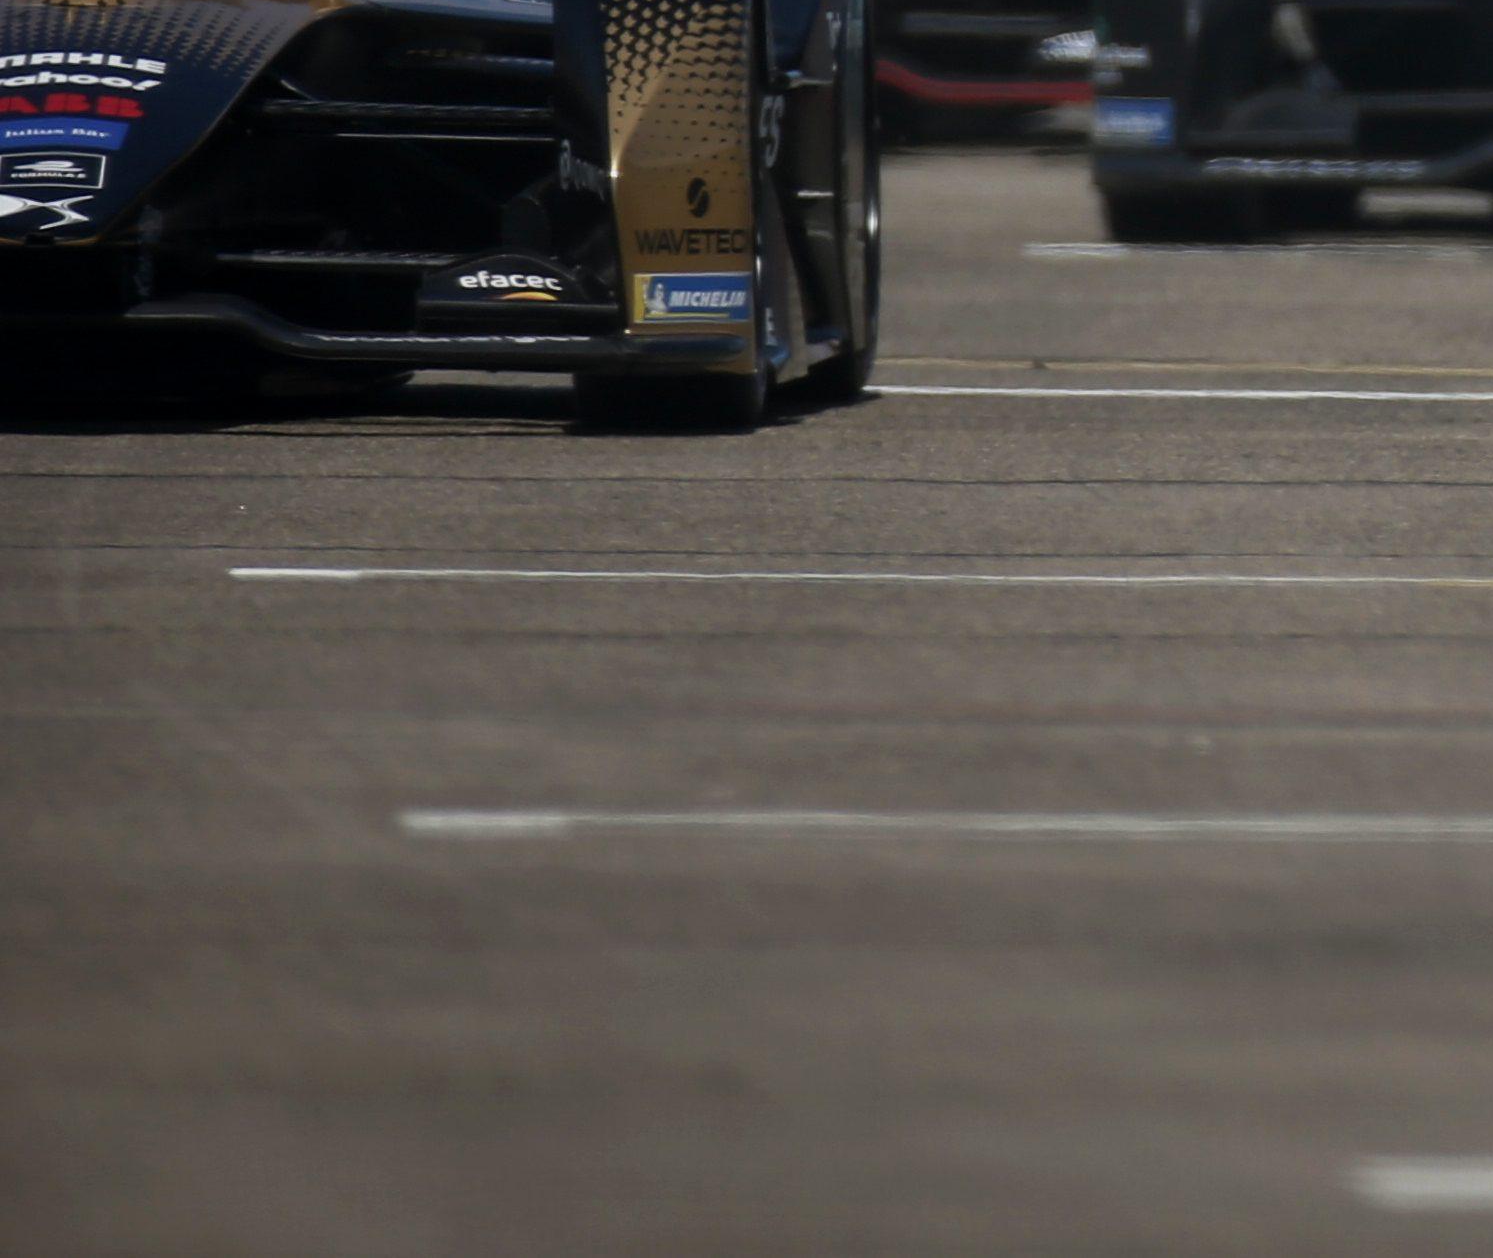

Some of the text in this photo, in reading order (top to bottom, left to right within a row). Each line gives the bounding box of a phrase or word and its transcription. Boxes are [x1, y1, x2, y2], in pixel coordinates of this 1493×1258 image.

[0, 71, 162, 91] ahoo!
[458, 270, 563, 291] efacec
[668, 290, 747, 307] MICHELIN
